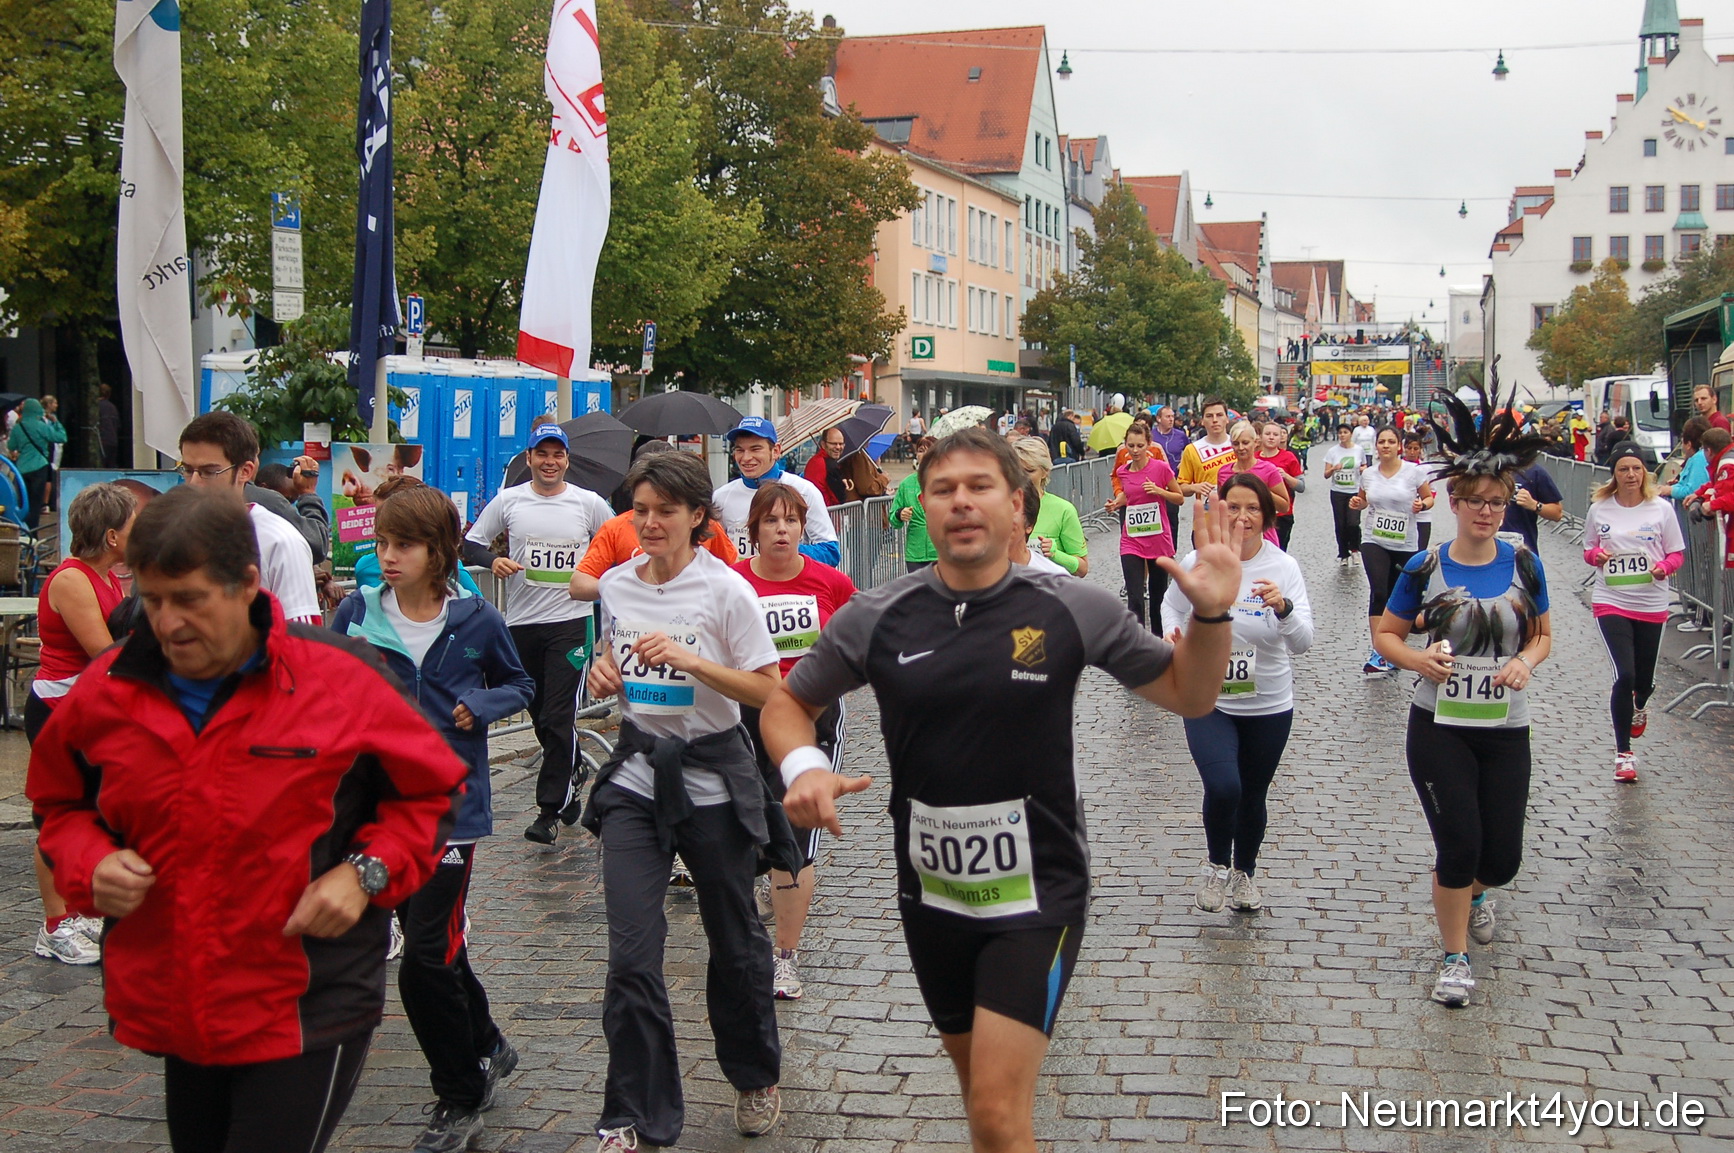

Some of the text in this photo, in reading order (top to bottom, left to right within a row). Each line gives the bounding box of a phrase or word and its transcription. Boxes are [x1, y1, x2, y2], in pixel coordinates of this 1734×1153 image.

[914, 339, 932, 356] D
[1342, 364, 1376, 373] START
[454, 394, 472, 418] DIXI
[500, 395, 517, 417] DIXI
[1203, 459, 1223, 472] MAX
[341, 519, 364, 530] BEIDE
[1129, 510, 1157, 526] 5027
[1376, 516, 1406, 532] 5030
[530, 550, 576, 569] 5164
[1608, 556, 1648, 574] 5149
[768, 601, 803, 609] Neumarkt
[1018, 631, 1034, 648] SV
[1011, 669, 1048, 682] Betreuer
[1466, 663, 1502, 672] Neumarkt
[628, 686, 667, 702] Andrea
[912, 811, 1003, 830] PARTL Neumarkt
[919, 831, 1018, 876] 5020
[942, 881, 1001, 903] Thomas
